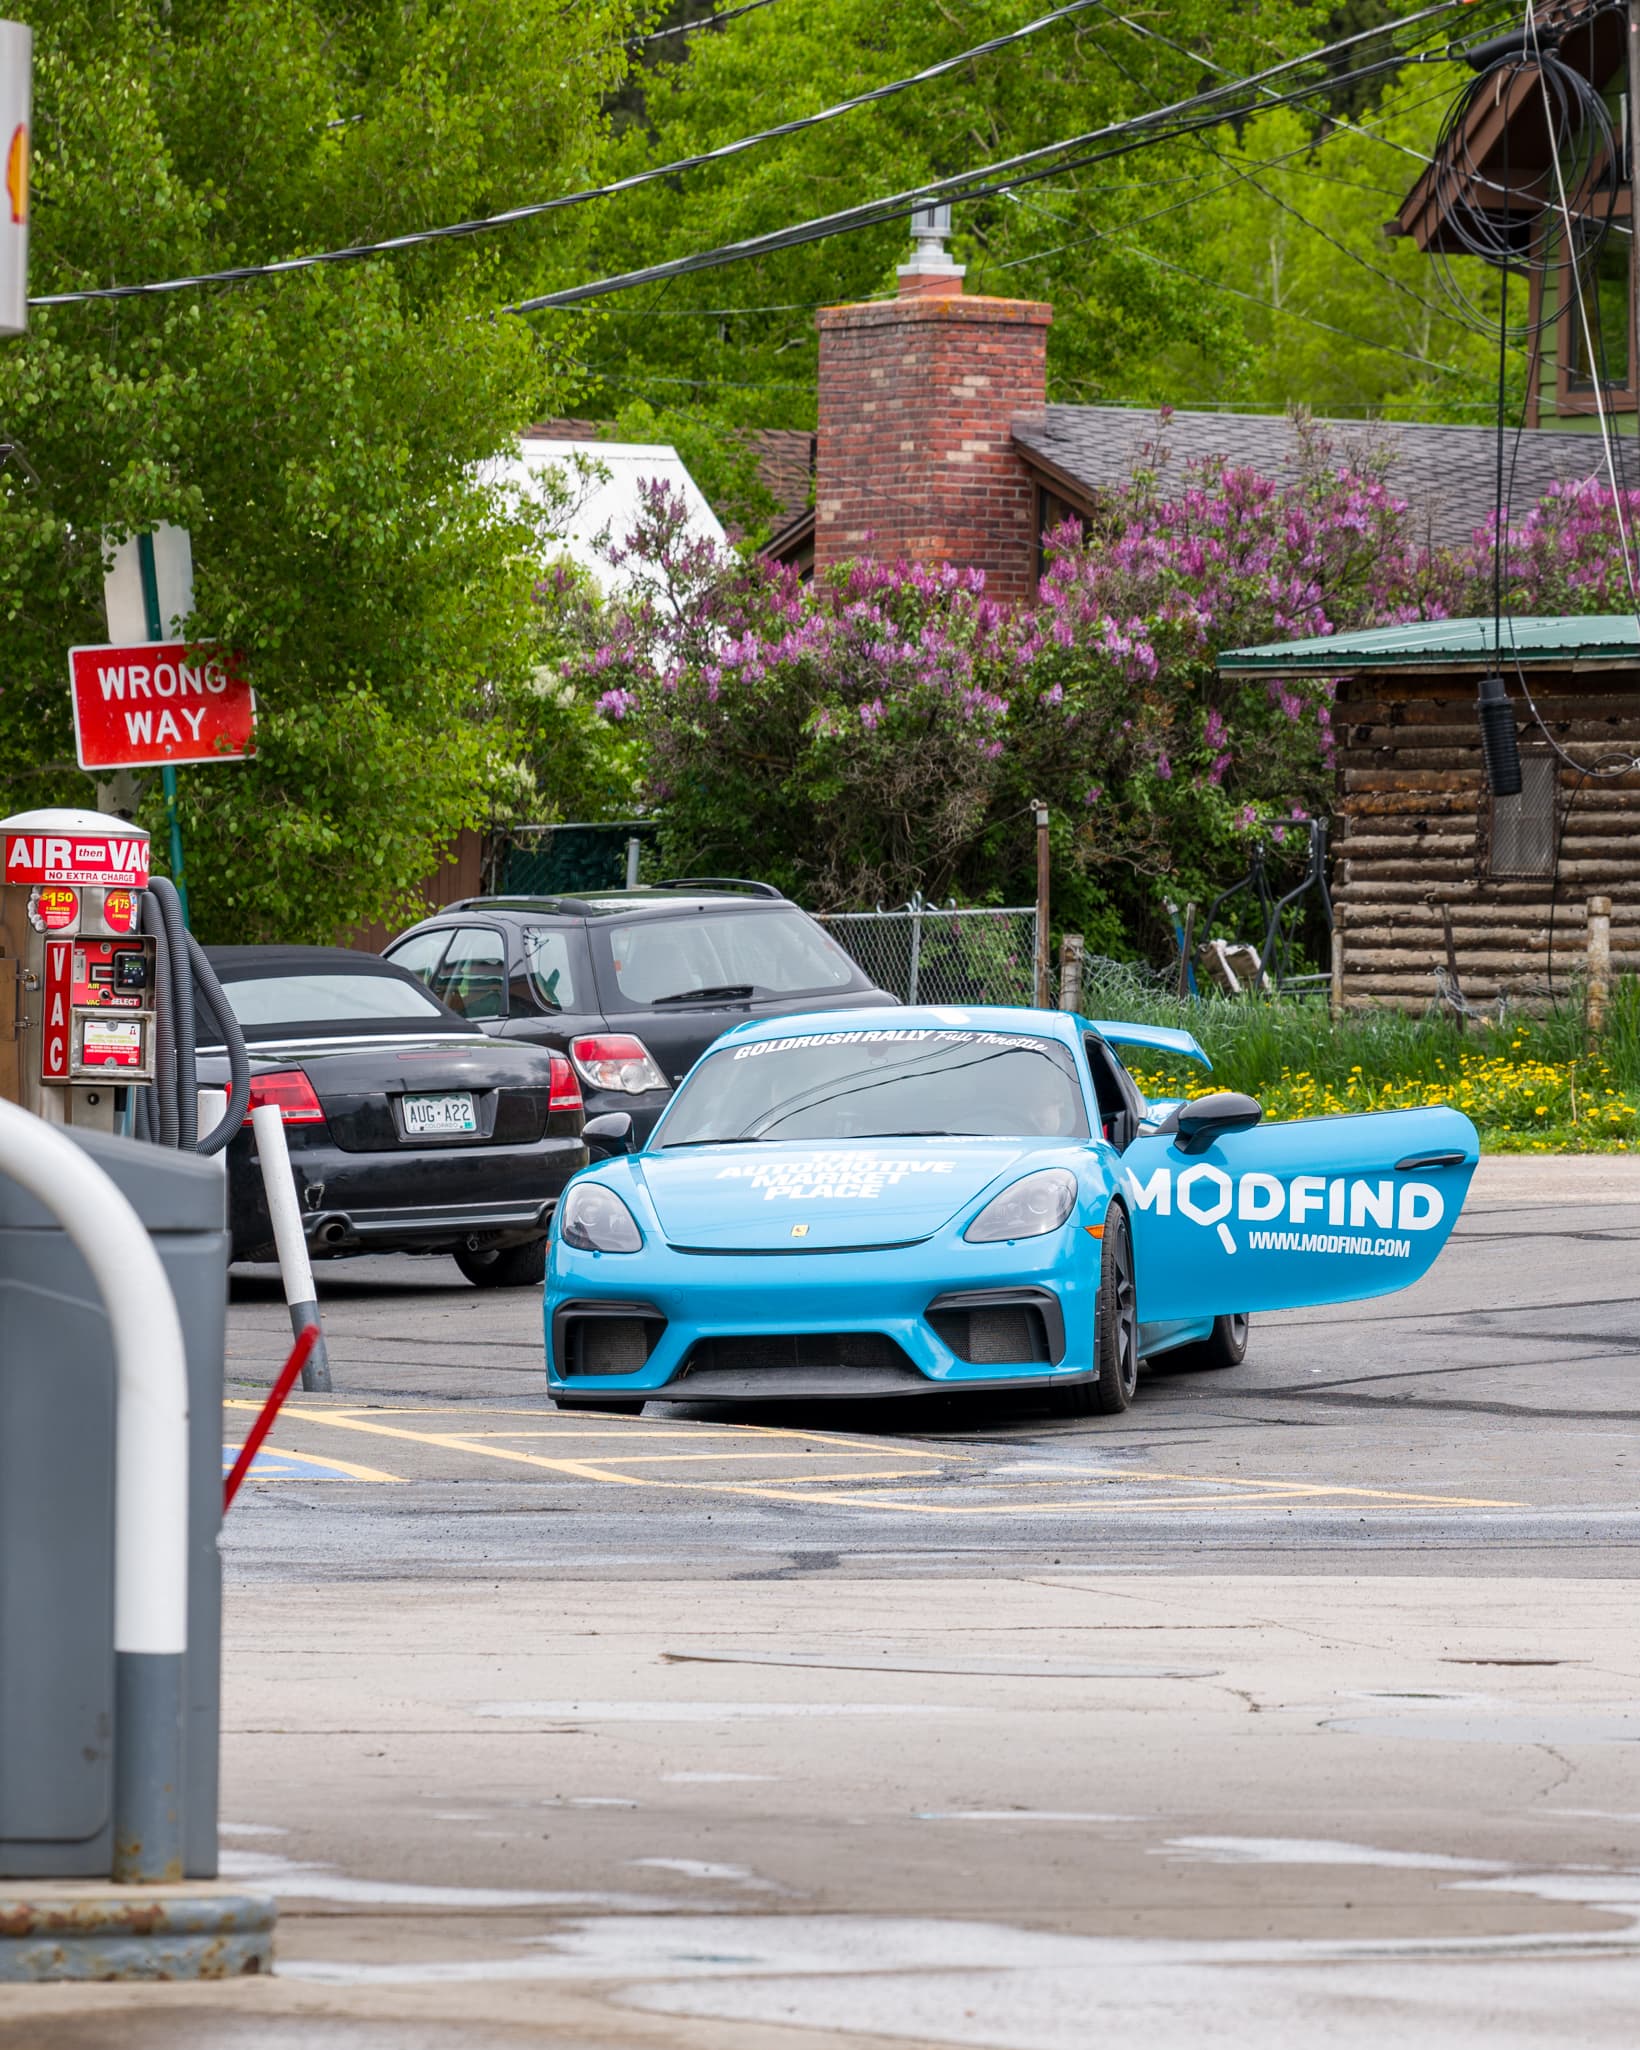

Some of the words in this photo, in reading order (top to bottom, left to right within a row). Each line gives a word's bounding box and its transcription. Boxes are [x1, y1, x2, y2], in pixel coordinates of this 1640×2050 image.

[97, 661, 227, 701] WRONG
[124, 707, 206, 745] WAY
[8, 838, 73, 869] AIR
[78, 848, 104, 858] then
[48, 871, 63, 880] NO
[66, 872, 98, 881] EXTRA
[101, 873, 133, 882] CHARGE
[111, 998, 138, 1006] SELECT
[861, 1030, 934, 1043] RALLY
[934, 1031, 974, 1042] Full
[975, 1033, 1049, 1051] Throttle
[811, 1151, 879, 1163] THE
[716, 1161, 957, 1179] AUTOMOTIVE
[751, 1171, 910, 1188] MARKET
[764, 1183, 885, 1200] PLACE
[1248, 1231, 1410, 1258] WWW.MODFIND.COM
